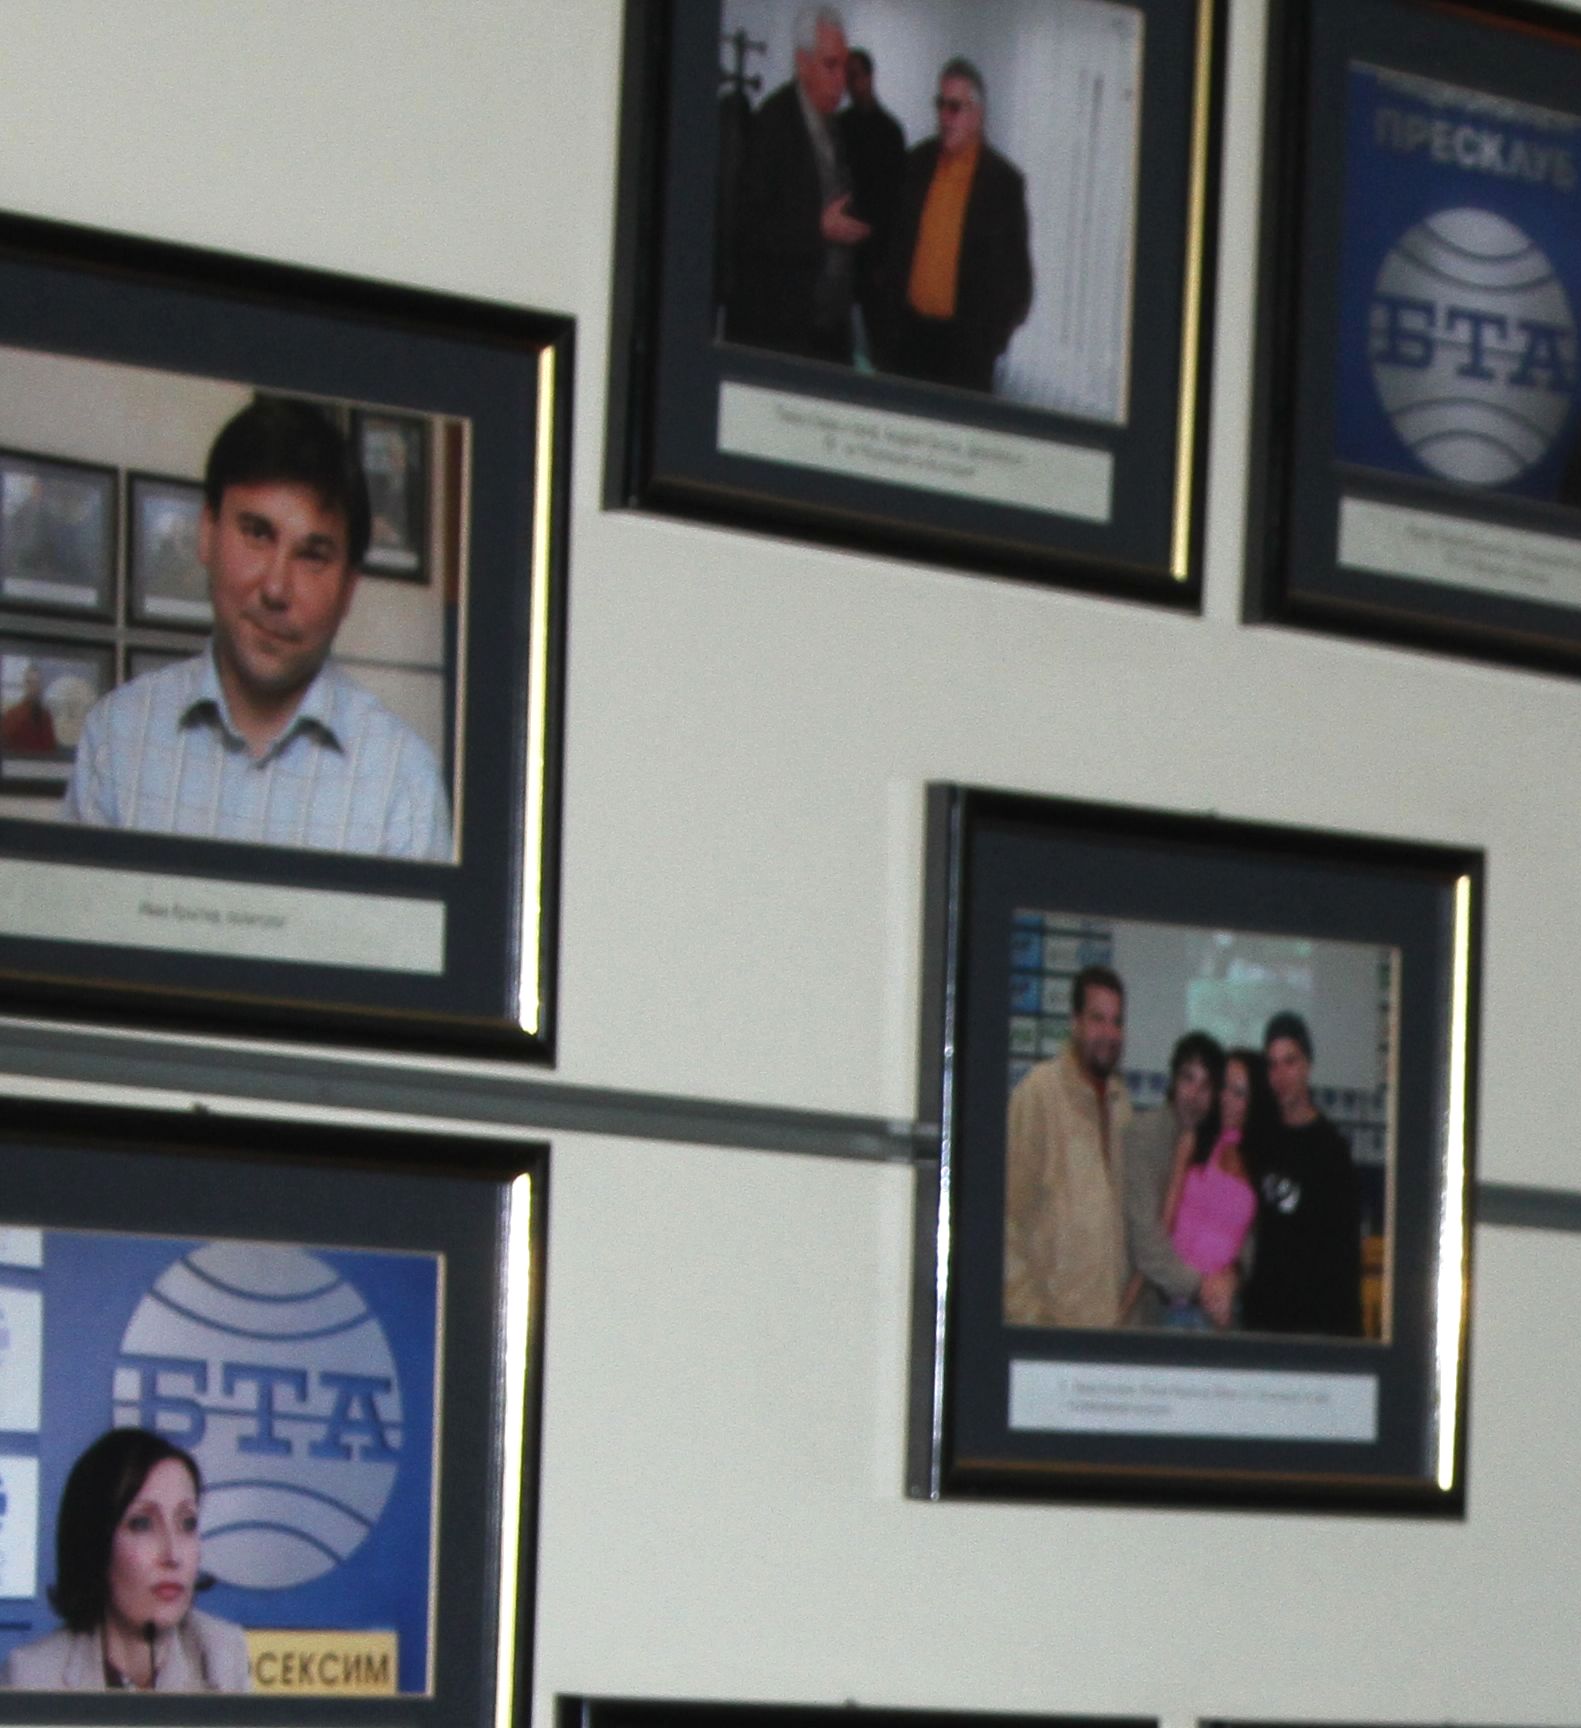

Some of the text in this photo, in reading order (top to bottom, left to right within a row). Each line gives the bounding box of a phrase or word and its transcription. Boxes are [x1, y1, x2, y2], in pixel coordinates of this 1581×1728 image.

[1374, 106, 1577, 191] ПРЕСКЛУБ
[1373, 292, 1577, 392] БТА
[118, 1353, 402, 1462] БТА
[247, 1653, 389, 1686] СЕКСИМ
